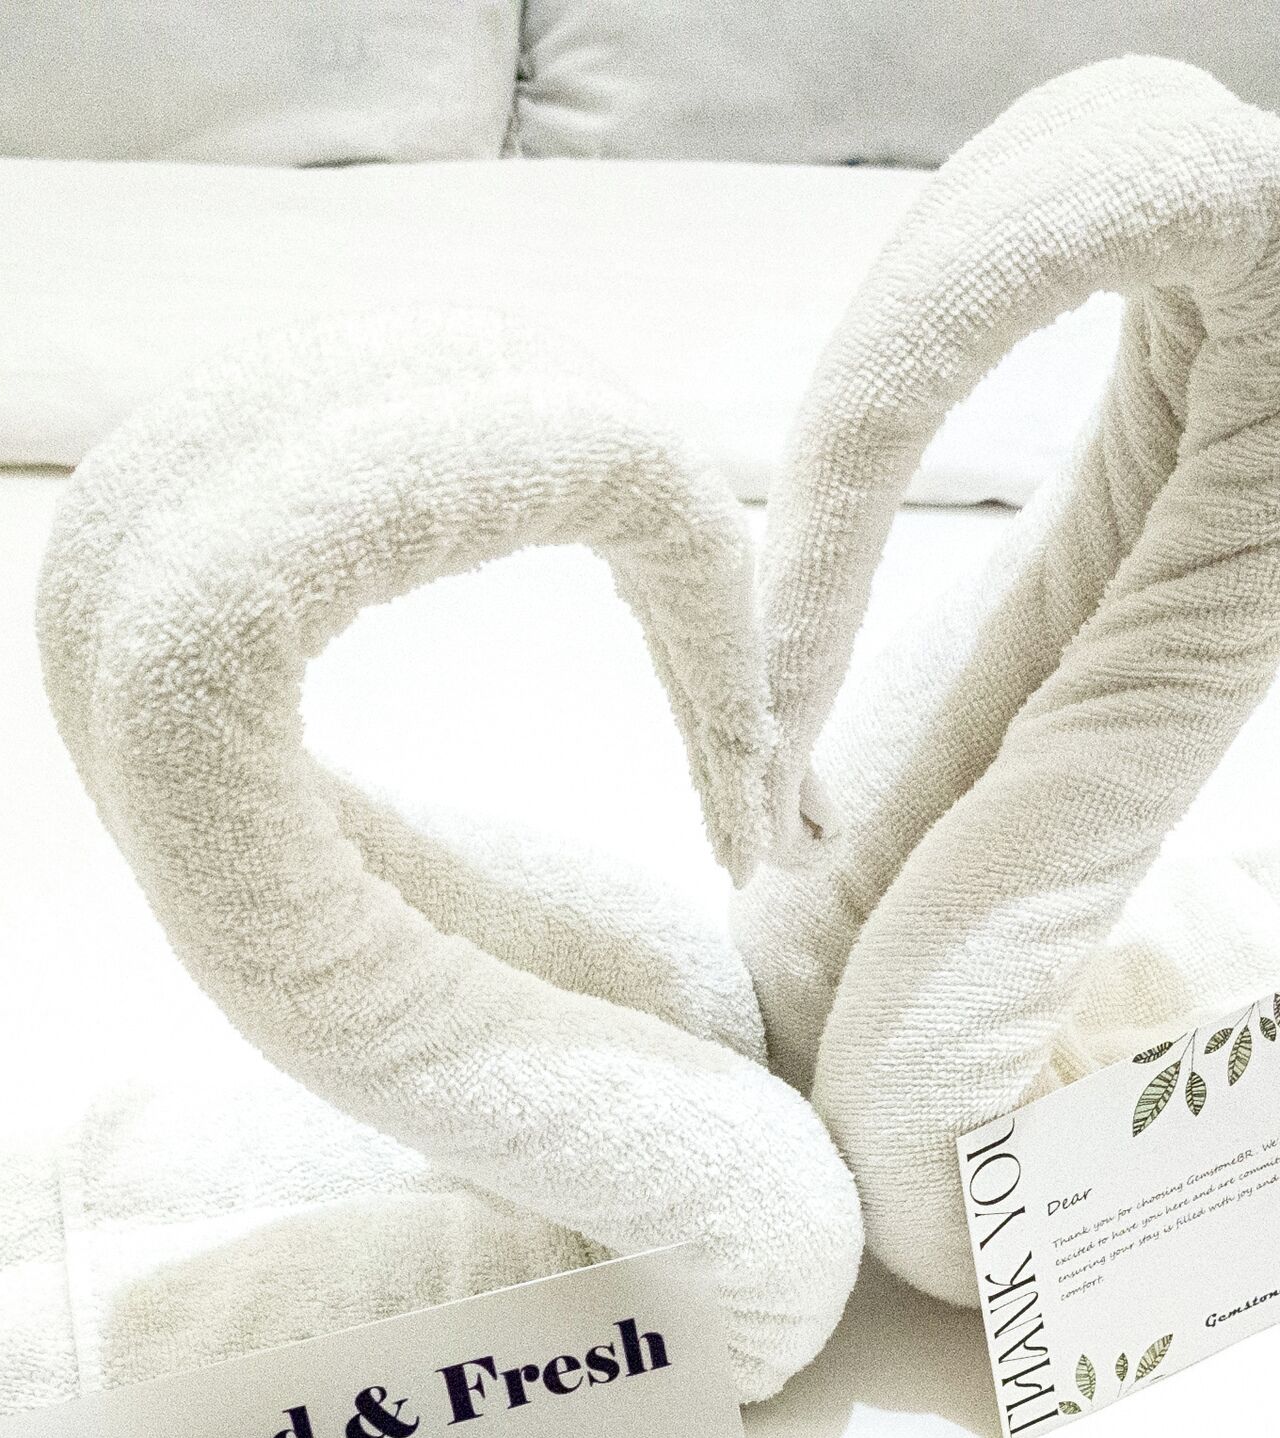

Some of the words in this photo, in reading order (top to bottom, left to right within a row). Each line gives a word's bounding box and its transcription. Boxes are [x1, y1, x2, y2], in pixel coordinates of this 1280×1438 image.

[1048, 1187, 1093, 1216] Dear
[1052, 1225, 1090, 1249] Thank
[1094, 1216, 1115, 1233] you
[1117, 1208, 1132, 1223] for
[1137, 1182, 1183, 1209] choosing
[1056, 1242, 1094, 1266] excited
[1098, 1237, 1110, 1247] to
[1112, 1223, 1137, 1240] have
[1142, 1211, 1163, 1228] you
[1165, 1198, 1189, 1214] here
[1192, 1185, 1215, 1201] and
[1218, 1177, 1235, 1190] are
[1059, 1257, 1106, 1283] ensuring
[1110, 1244, 1134, 1260] your
[1138, 1231, 1160, 1247] stay
[1163, 1225, 1173, 1233] is
[1176, 1209, 1206, 1231] filled
[1209, 1195, 1235, 1212] with
[1236, 1186, 1253, 1202] joy
[1256, 1175, 1280, 1190] and
[436, 1316, 672, 1430] Fresh
